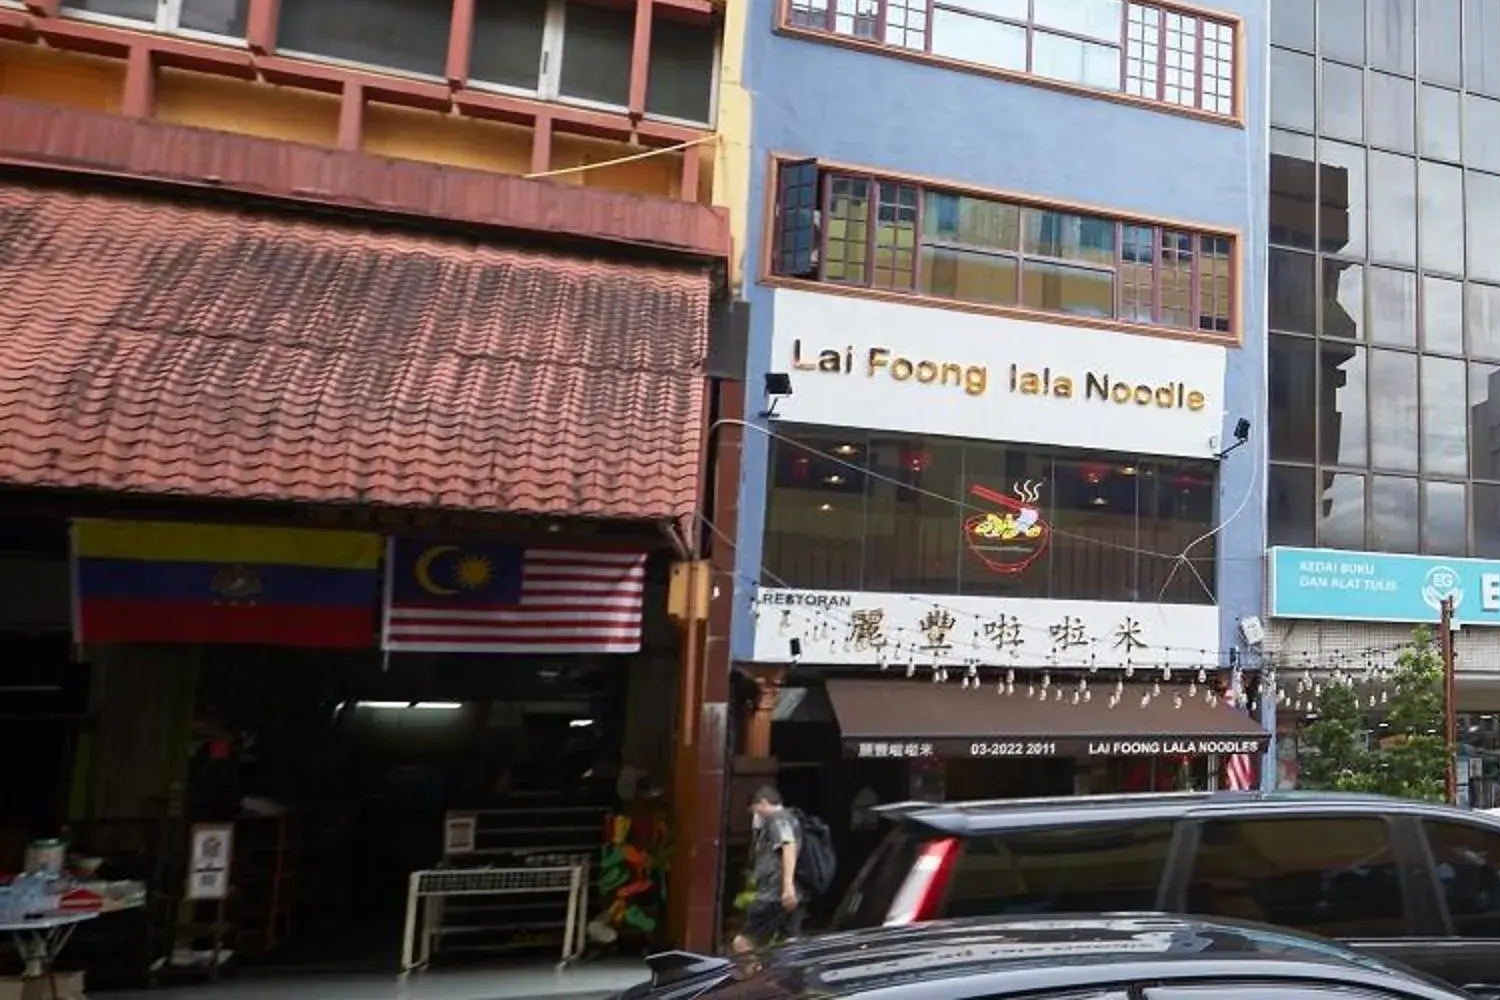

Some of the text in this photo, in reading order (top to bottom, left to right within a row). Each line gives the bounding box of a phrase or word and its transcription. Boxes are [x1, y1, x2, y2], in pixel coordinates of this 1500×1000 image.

[793, 338, 1206, 412] Lai Foong lala Noodle
[1299, 560, 1375, 576] KEDAI BUKU
[1300, 575, 1327, 588] DAN
[1330, 577, 1360, 590] ALAT
[1432, 573, 1454, 588] EG
[763, 593, 851, 607] RESTORAN
[971, 741, 1056, 756] 03-2022 2011
[1088, 740, 1259, 756] LAI FOONG LALA NOODLES
